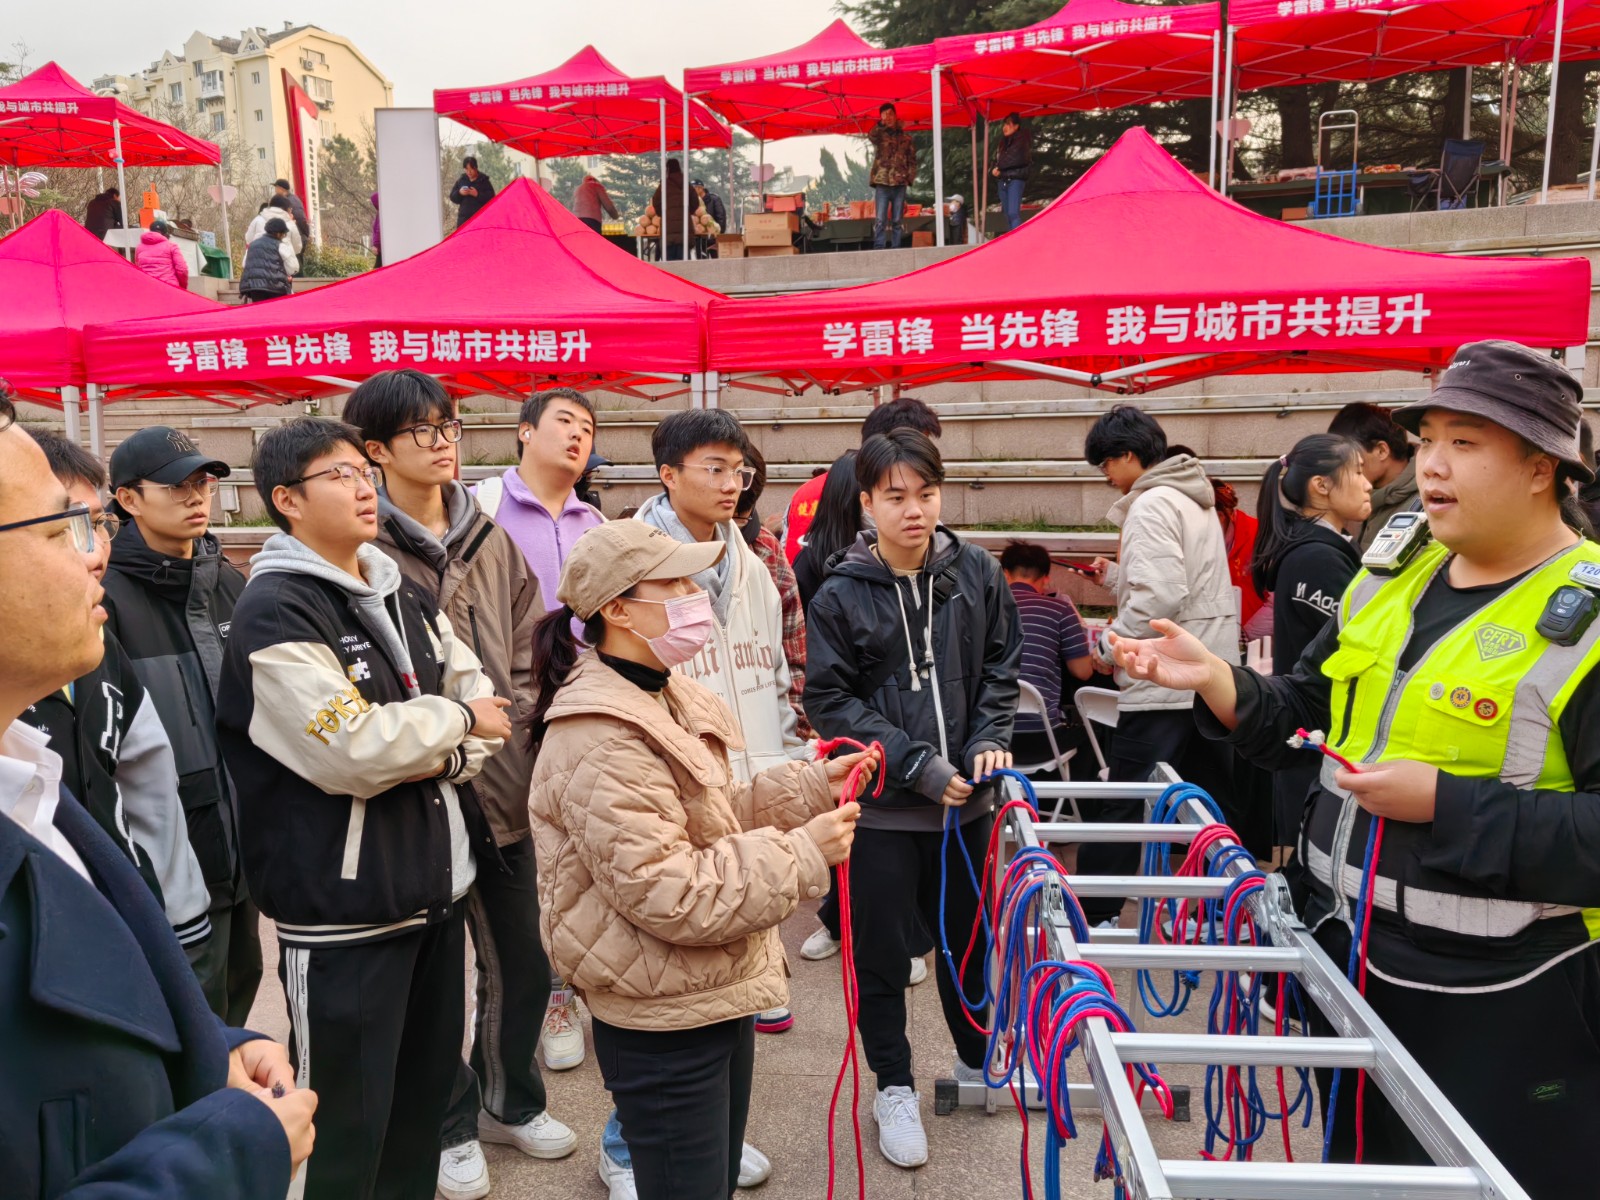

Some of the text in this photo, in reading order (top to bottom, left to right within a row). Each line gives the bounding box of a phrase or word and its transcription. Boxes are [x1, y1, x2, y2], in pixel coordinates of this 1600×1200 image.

[974, 15, 1174, 55] 学雷锋 当先锋 我与城市共提升
[720, 56, 895, 84] 学雷锋 当先锋 我与城市共提升
[469, 83, 630, 105] 学雷锋 当先锋 我与城市共提升
[822, 293, 1431, 359] 学雷锋 当先锋 我与城市共提升
[165, 329, 592, 373] 学雷锋 当先锋 我与城市共提升
